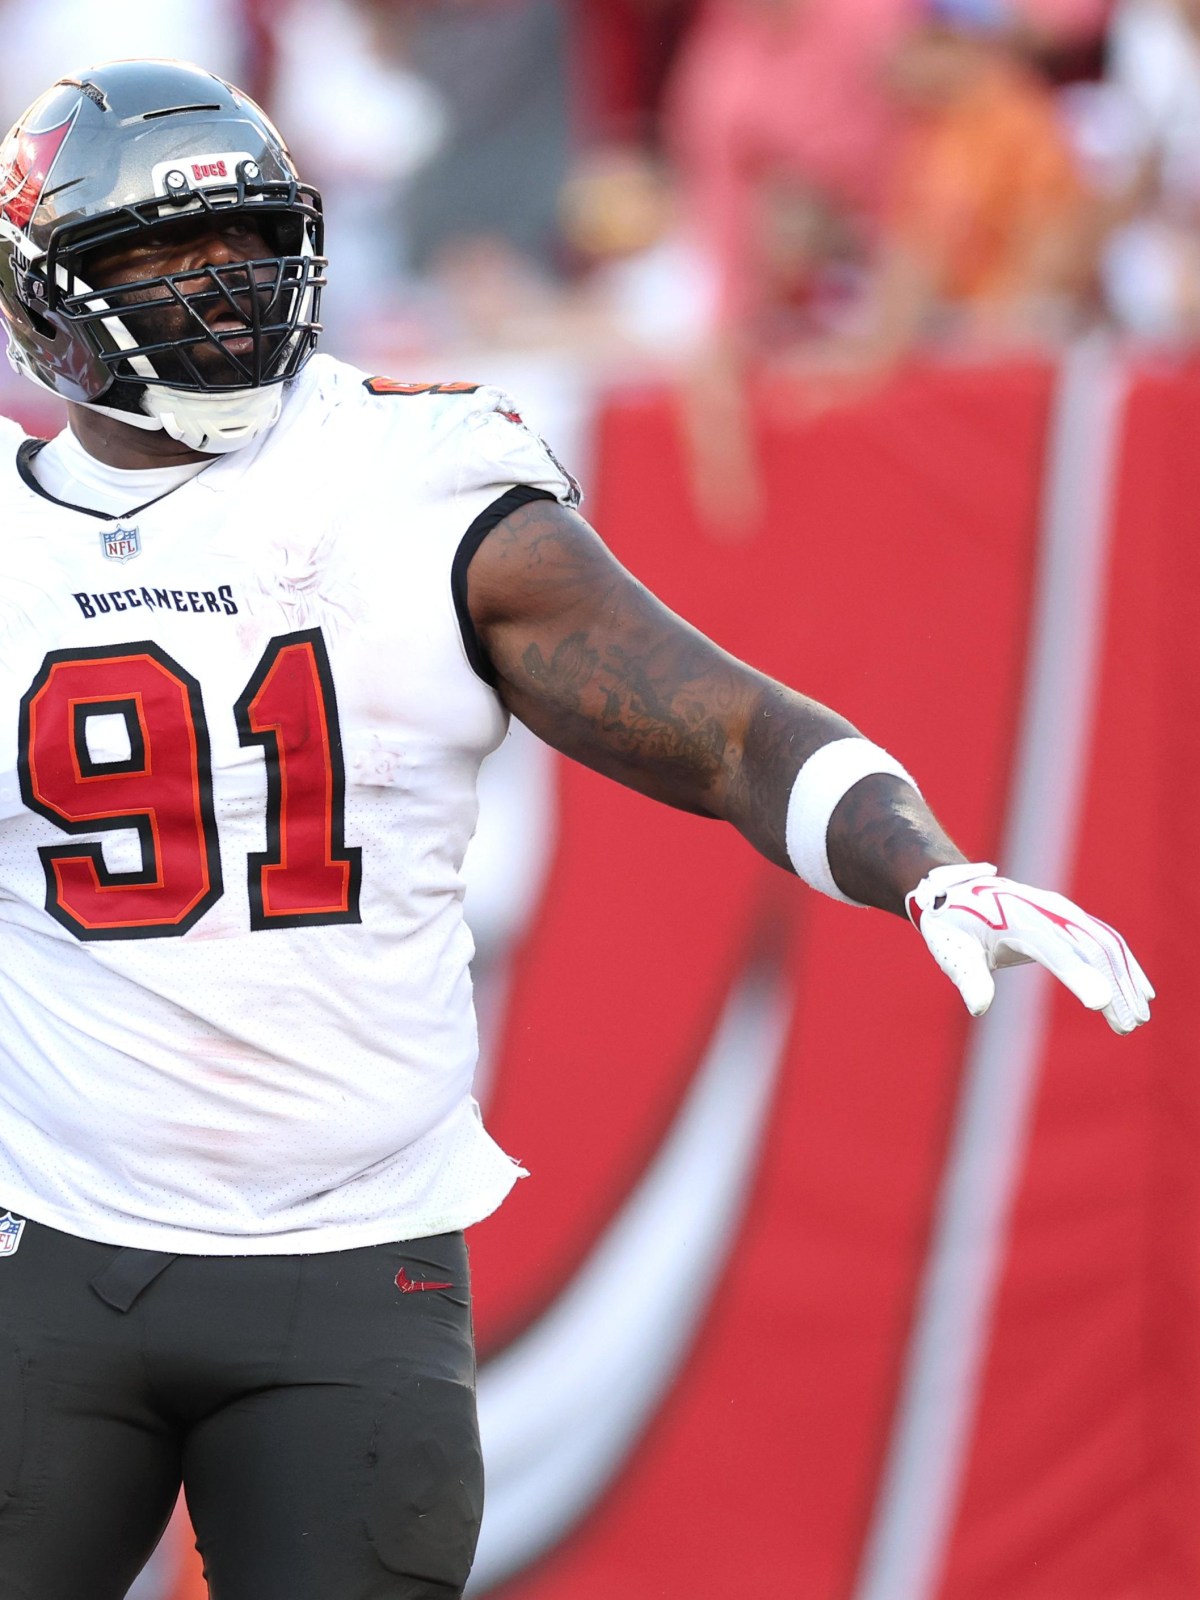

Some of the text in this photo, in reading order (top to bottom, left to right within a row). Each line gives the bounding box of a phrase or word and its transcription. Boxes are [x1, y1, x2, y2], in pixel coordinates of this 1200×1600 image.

[191, 160, 228, 181] BUCS
[107, 540, 136, 556] NFL
[71, 585, 238, 619] BUCCANEERS
[17, 626, 362, 942] 91
